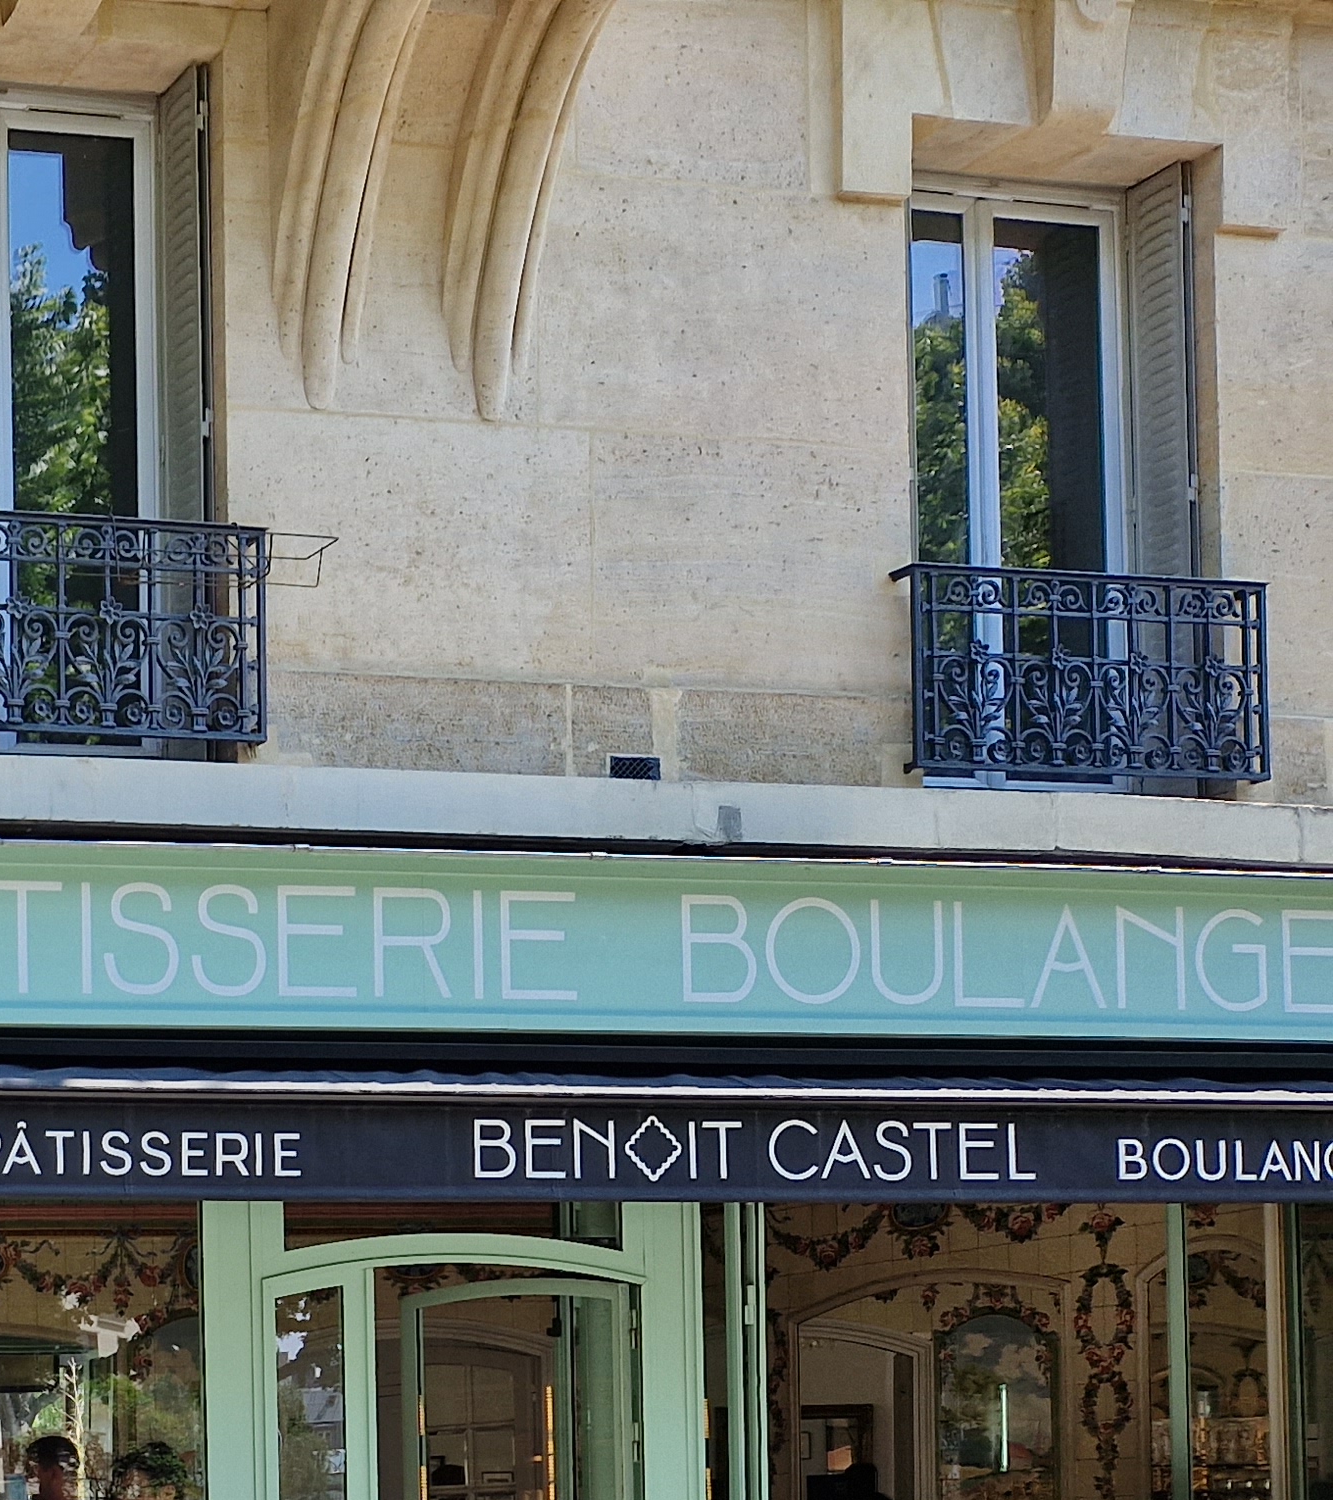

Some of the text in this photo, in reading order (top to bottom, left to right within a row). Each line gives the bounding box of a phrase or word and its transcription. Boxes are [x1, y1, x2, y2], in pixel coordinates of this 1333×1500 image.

[681, 893, 1333, 1013] BOULANGE
[473, 1114, 1037, 1182] BENOIT CASTEL
[1117, 1137, 1333, 1182] BOULAN
